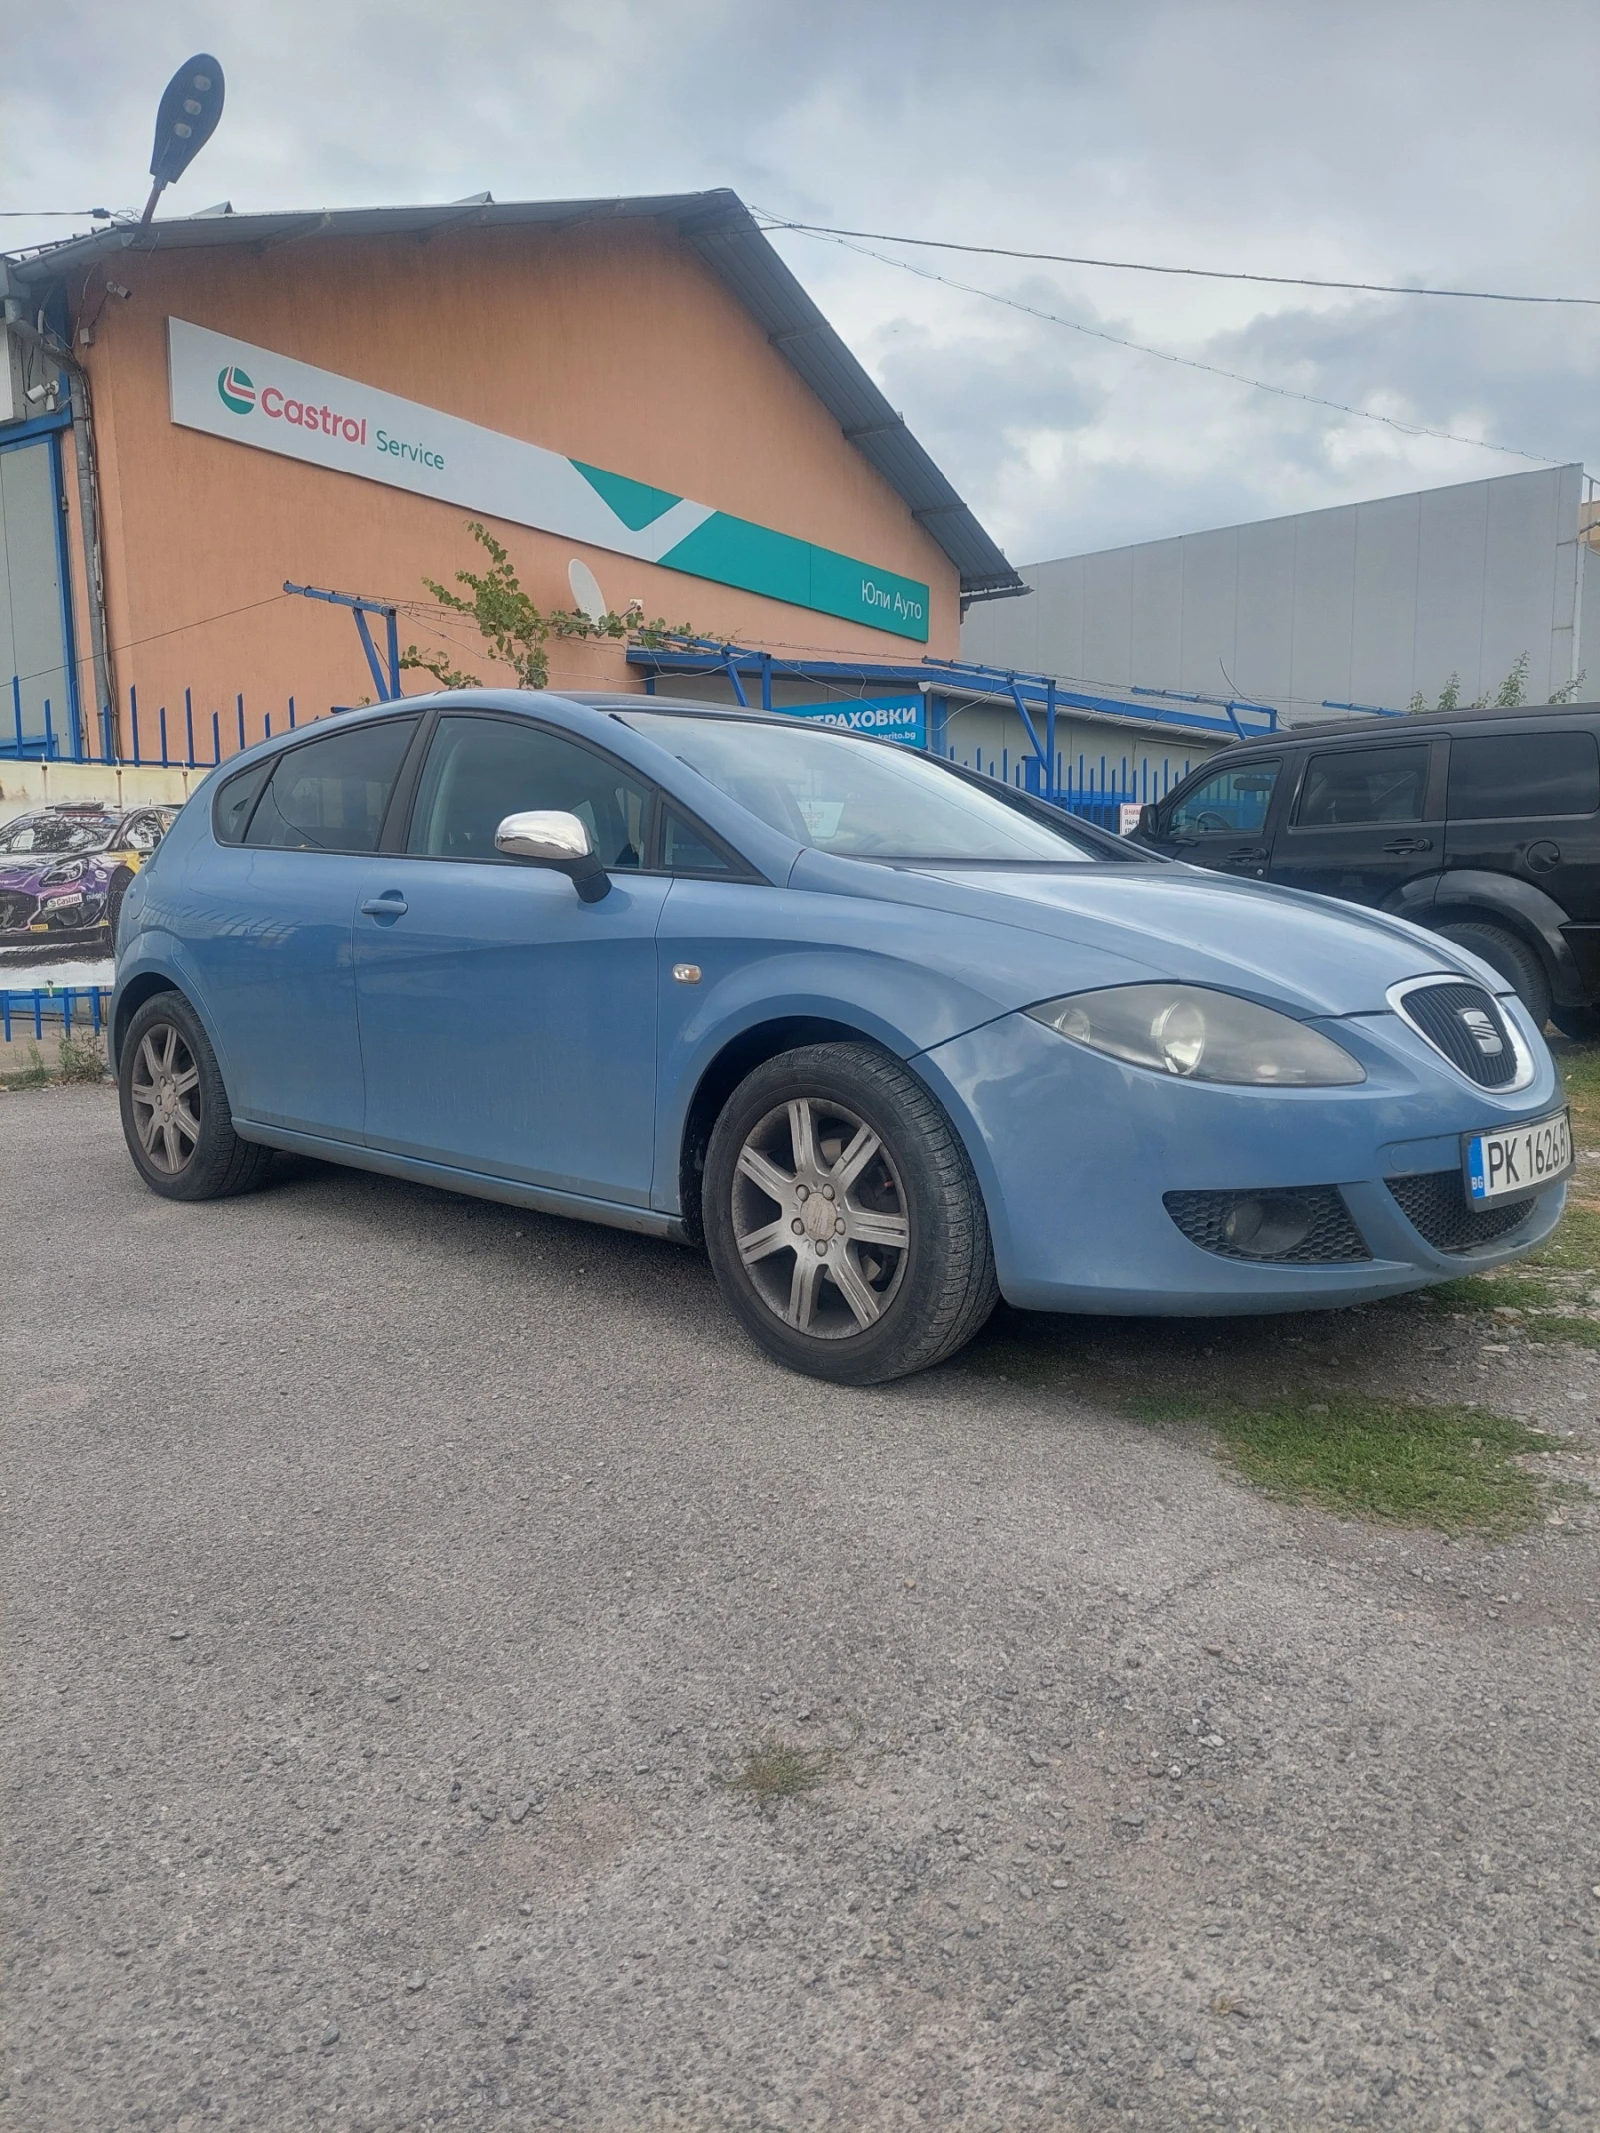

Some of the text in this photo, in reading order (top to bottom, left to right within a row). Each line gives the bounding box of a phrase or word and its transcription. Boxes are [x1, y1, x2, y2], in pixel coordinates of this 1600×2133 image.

[261, 387, 445, 470] Castrol Service
[861, 579, 922, 621] Юли Ауто
[57, 895, 80, 905] Castrol
[1471, 1177, 1484, 1190] BG
[1488, 1137, 1520, 1188] PK
